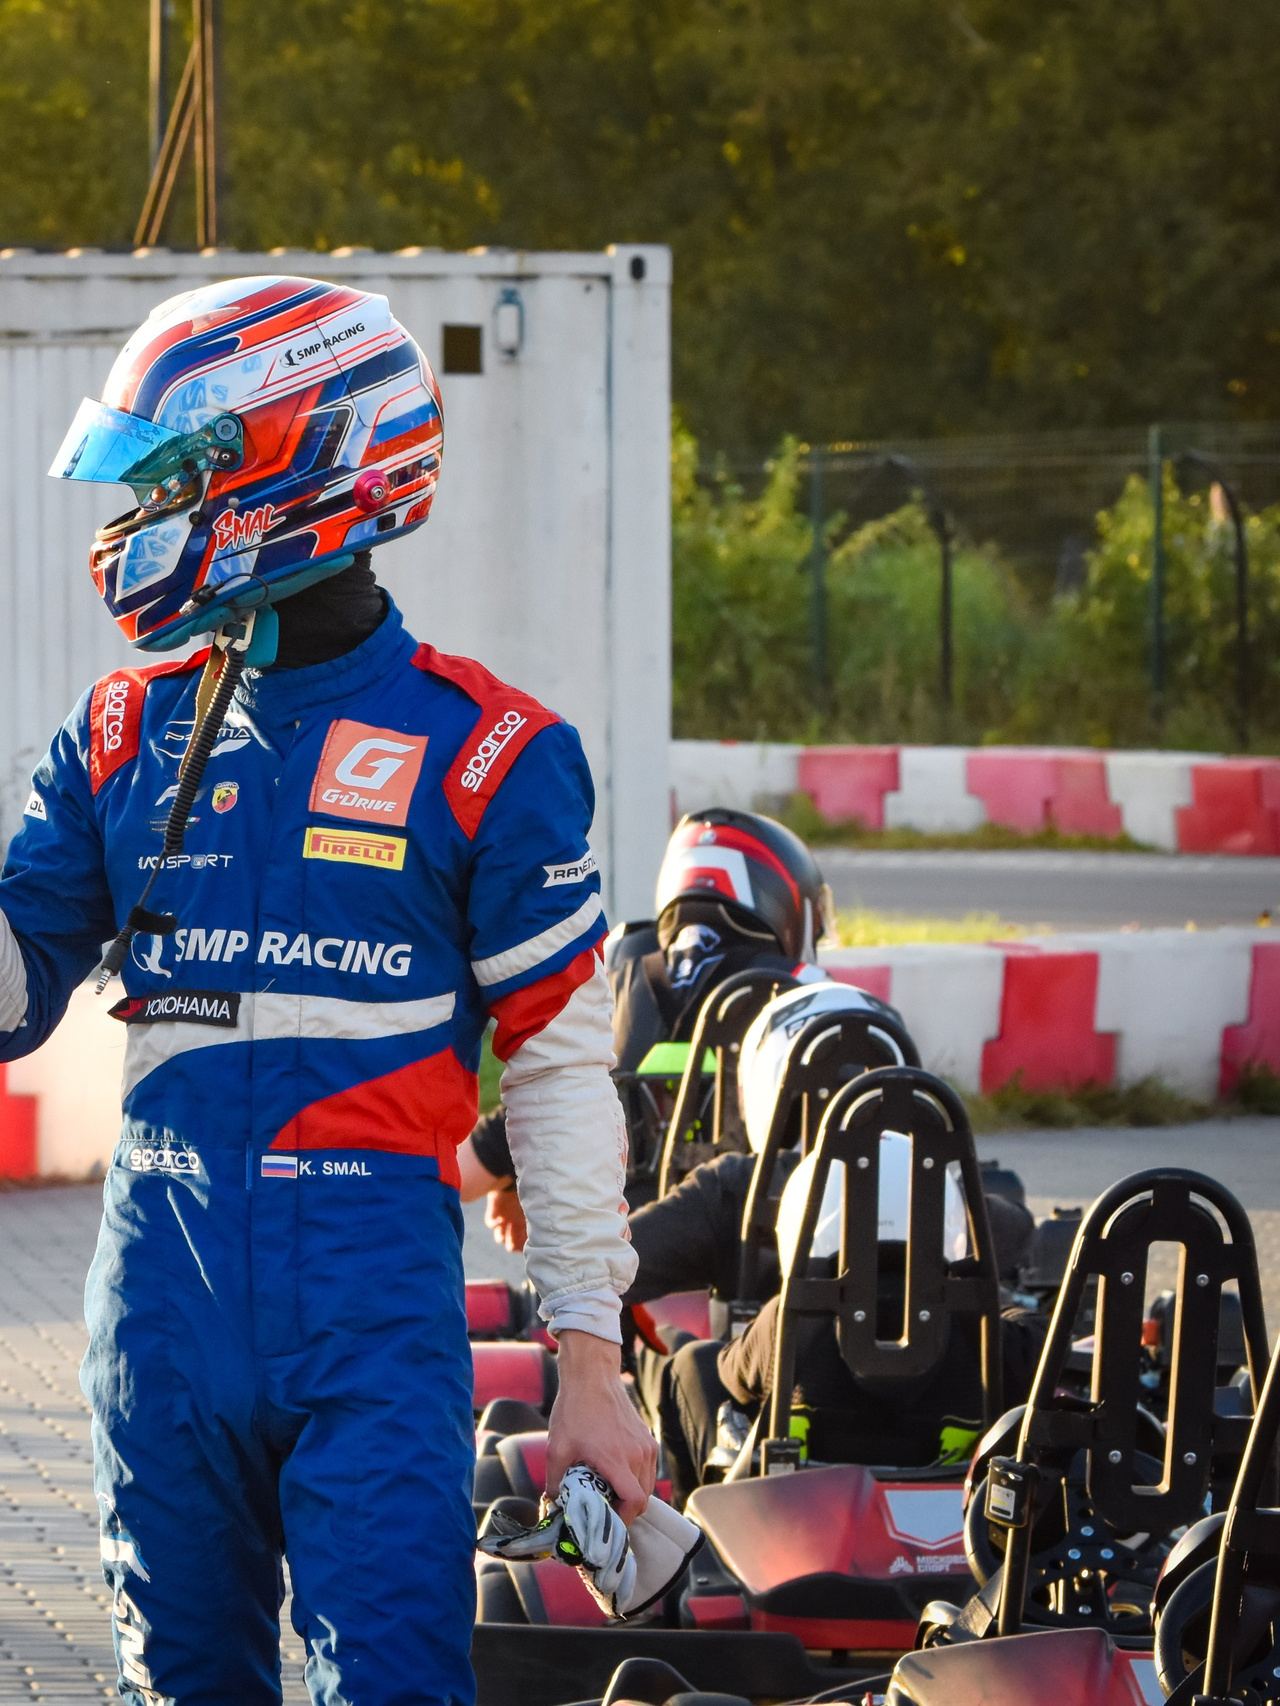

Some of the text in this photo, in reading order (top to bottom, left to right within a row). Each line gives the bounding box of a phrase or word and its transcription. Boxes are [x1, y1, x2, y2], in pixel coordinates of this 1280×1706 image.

[297, 322, 366, 360] SMP RACING
[213, 504, 286, 551] SMAL
[105, 681, 130, 751] sparco
[461, 711, 524, 790] sparco
[311, 833, 398, 863] PIRELLI
[174, 928, 413, 977] SMP RACING
[145, 996, 231, 1020] YOKOHAMA
[130, 1148, 199, 1172] sparco
[299, 1160, 372, 1177] K. SMAL
